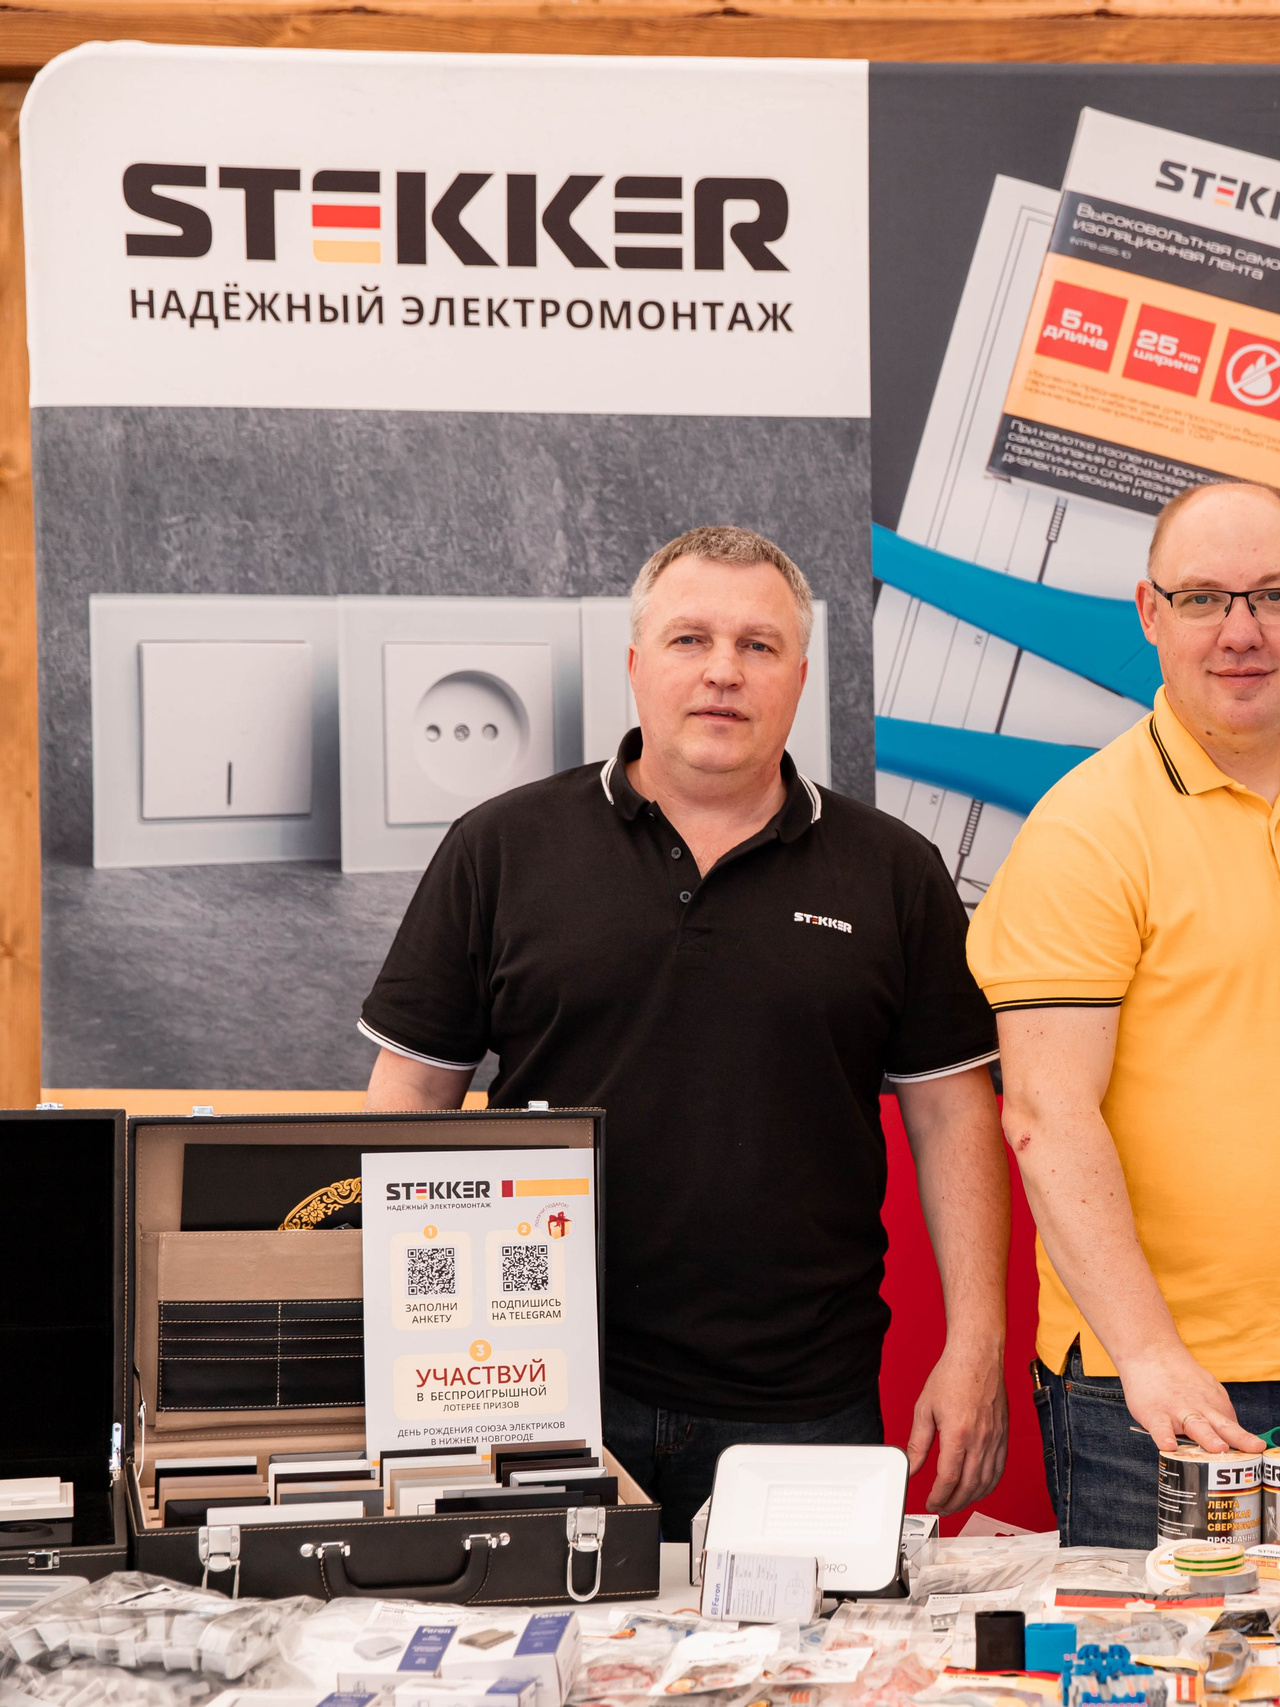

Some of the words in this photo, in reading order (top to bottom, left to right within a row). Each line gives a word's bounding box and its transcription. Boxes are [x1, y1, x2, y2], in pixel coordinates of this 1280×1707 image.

[123, 163, 790, 271] STEKKER
[1076, 202, 1232, 257] Высоковольтная
[1072, 219, 1205, 264] изоляционная
[1208, 256, 1264, 281] лента
[131, 284, 384, 329] НАДЁЖНЫЙ
[401, 296, 794, 332] ЭЛЕКТРОМОНТАЖ
[1061, 307, 1083, 330] 5
[1043, 324, 1109, 351] длина
[1136, 329, 1180, 357] 25
[1133, 348, 1199, 375] ширина
[1007, 432, 1107, 466] самослипания
[1010, 419, 1038, 436] При
[1038, 429, 1097, 453] намотке
[1096, 445, 1166, 471] изоленты
[794, 911, 853, 934] STEKKER
[386, 1180, 491, 1201] STEKKER
[430, 1202, 492, 1210] ЭЛЕКТРОМОНТАЖ
[405, 1302, 458, 1312] ЗАПОЛНИ
[491, 1299, 562, 1310] ПОДПИШИСЬ
[492, 1312, 506, 1320] НА
[509, 1310, 562, 1320] TELEGRAM
[412, 1314, 452, 1323] АНКЕТУ
[415, 1358, 546, 1388] УЧАСТВУЙ
[417, 1393, 424, 1402] В
[431, 1386, 547, 1401] БЕСПРОИГРЫШНОЙ
[443, 1402, 480, 1412] ЛОТЕРЕЕ
[483, 1401, 519, 1410] ПРИЗОВ
[397, 1429, 421, 1438] ДЕНЬ
[423, 1426, 473, 1435] РОЖДЕНИЯ
[475, 1424, 507, 1433] СОЮЗА
[509, 1421, 565, 1431] ЭЛЕКТРИКОВ
[431, 1437, 437, 1445] В
[439, 1435, 479, 1445] НИЖНЕМ
[481, 1433, 534, 1443] НОВГОРОДЕ
[1207, 1510, 1250, 1520] КЛЕЙКАЯ
[1208, 1500, 1239, 1509] ЛЕНТА
